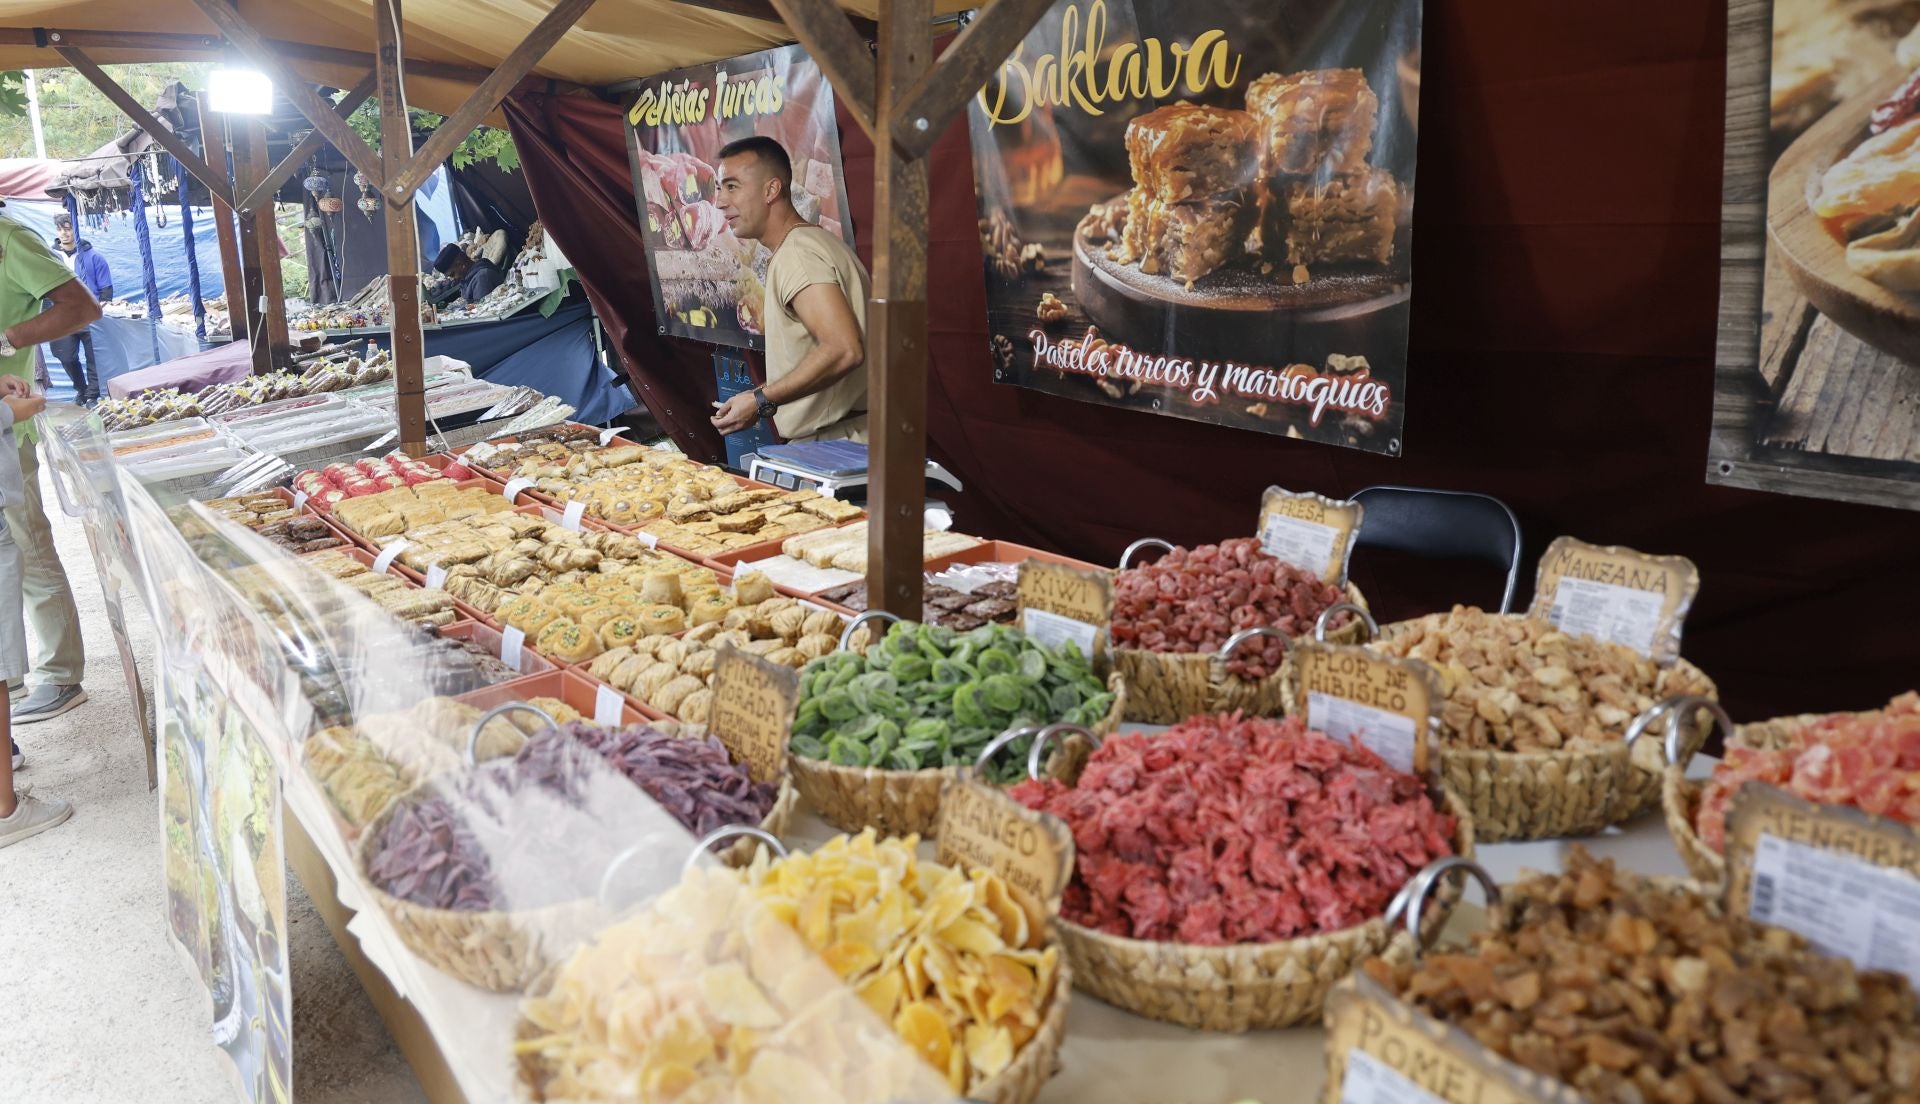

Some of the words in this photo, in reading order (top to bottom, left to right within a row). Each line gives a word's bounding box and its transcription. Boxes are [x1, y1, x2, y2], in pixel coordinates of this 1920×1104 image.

[978, 0, 1242, 132] Baklava
[628, 78, 710, 127] Delicias
[713, 70, 786, 121] Turcas
[1028, 328, 1111, 376] Pasteles
[1114, 345, 1194, 388] turcos
[1191, 361, 1219, 402] y
[1221, 362, 1389, 424] marroquíes
[1280, 500, 1326, 524] FRESA
[1032, 570, 1088, 604] KIWI
[1552, 550, 1668, 595] MANZANA
[1308, 670, 1407, 712] HIBISCO
[1313, 653, 1373, 683] FLOR
[1384, 669, 1409, 691] DE
[766, 729, 778, 749] C
[949, 786, 1039, 857] MANGO
